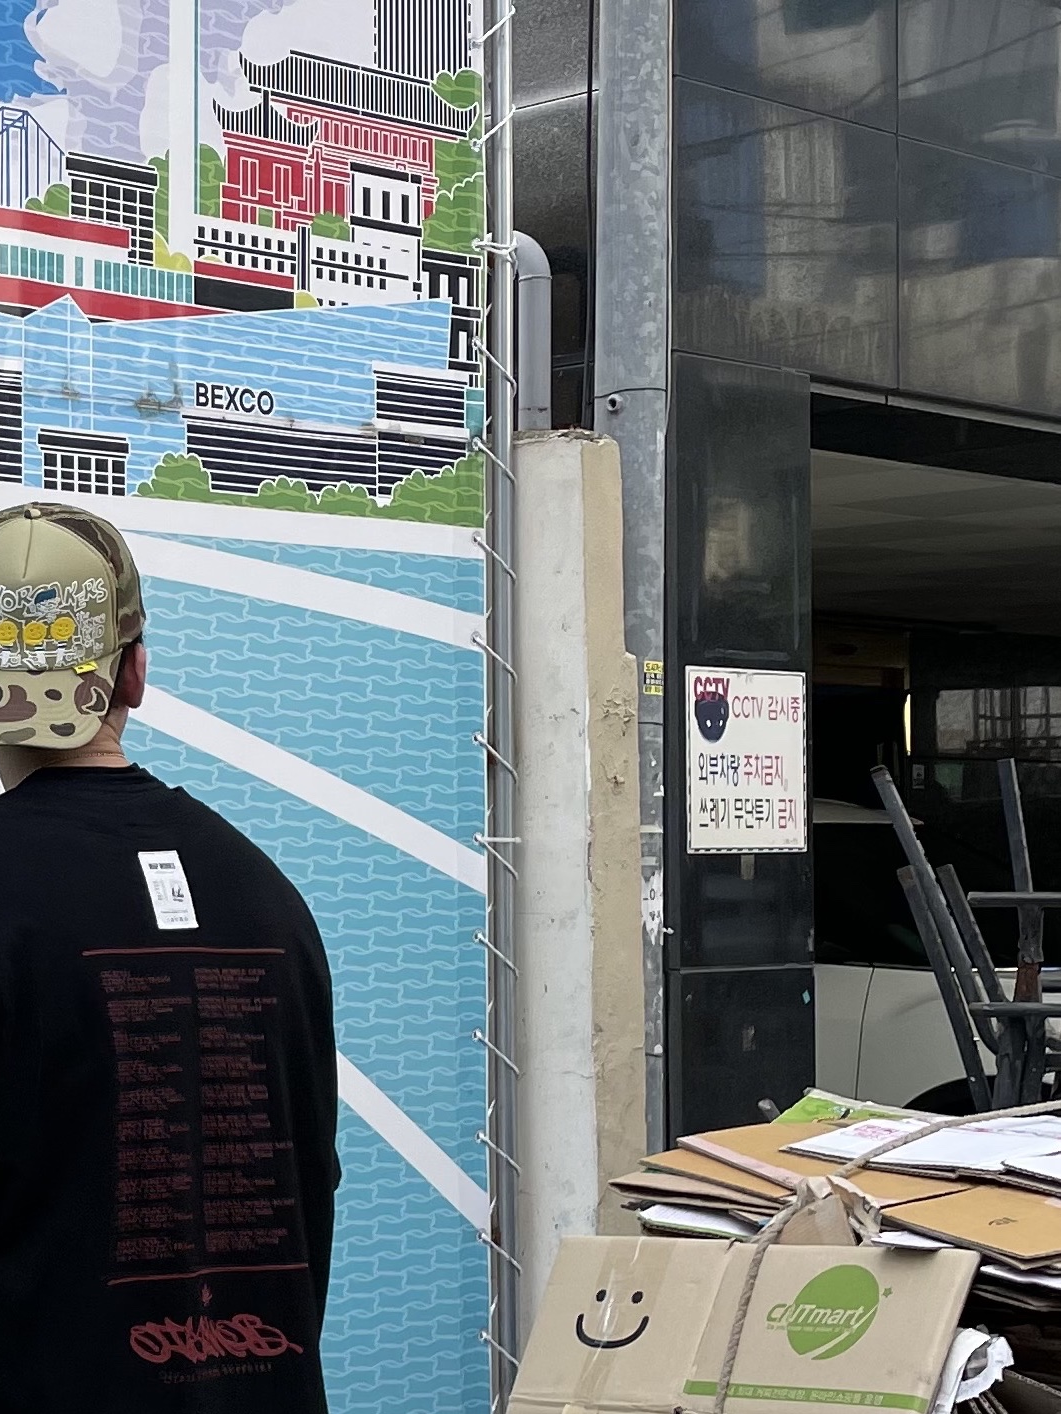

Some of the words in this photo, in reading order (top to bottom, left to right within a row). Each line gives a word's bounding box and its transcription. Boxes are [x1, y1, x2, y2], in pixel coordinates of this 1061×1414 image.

[195, 382, 274, 415] BEXCO
[694, 676, 730, 701] CCTV
[731, 695, 764, 719] CCTV
[768, 696, 801, 723] 감시중
[698, 752, 741, 787] 외부차량
[743, 754, 784, 786] 주차금지
[699, 797, 731, 829] 쓰레기
[734, 798, 775, 830] 무단투기
[778, 798, 797, 830] 금지
